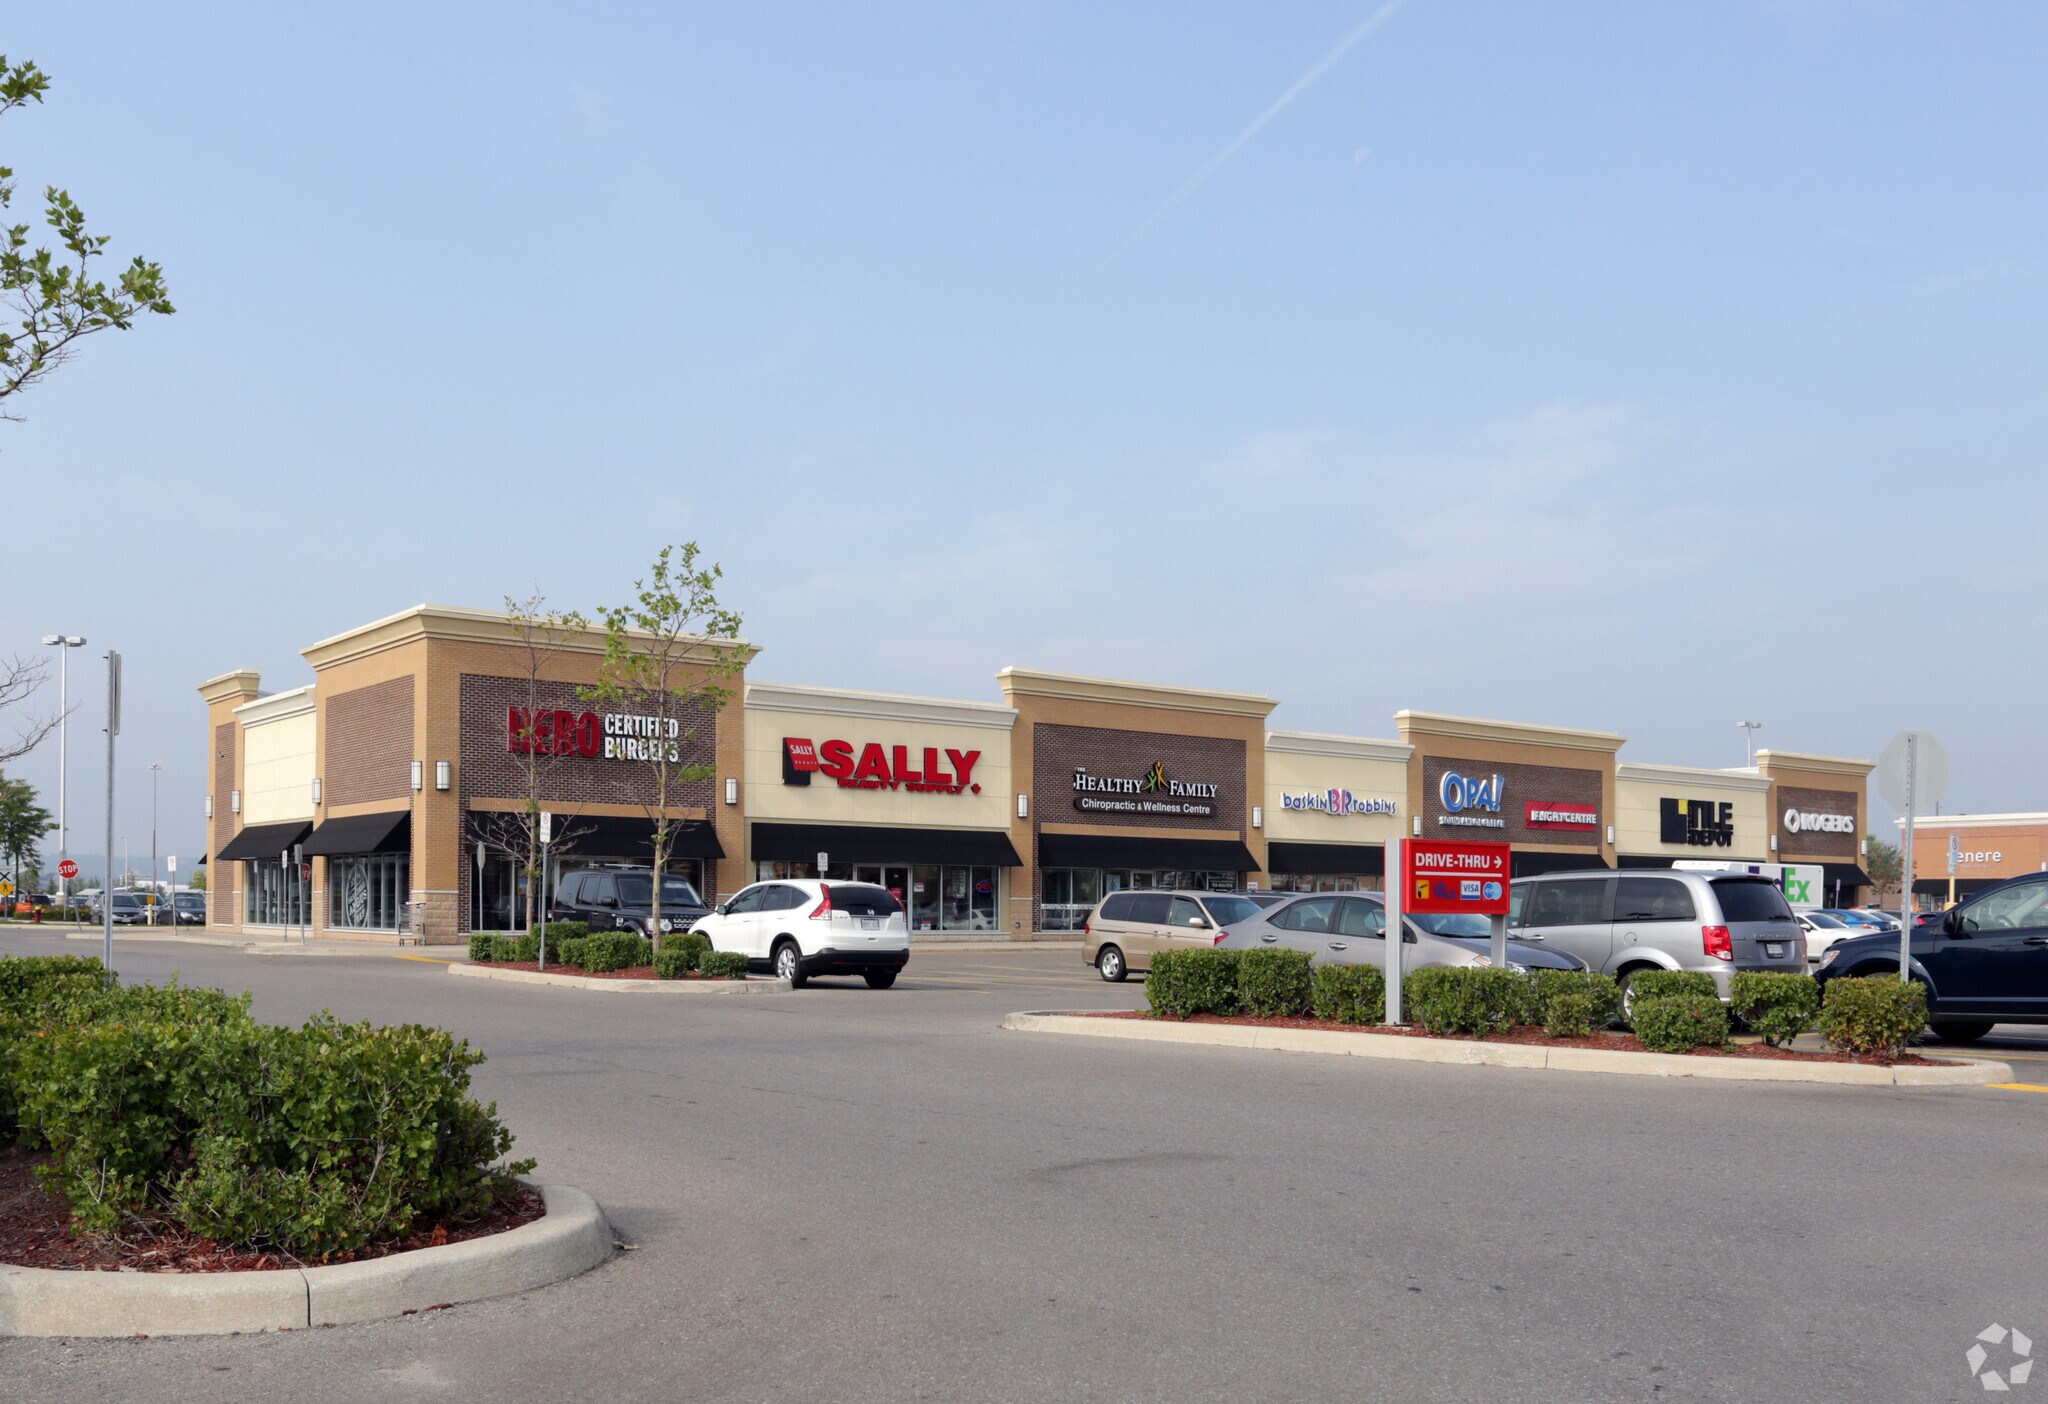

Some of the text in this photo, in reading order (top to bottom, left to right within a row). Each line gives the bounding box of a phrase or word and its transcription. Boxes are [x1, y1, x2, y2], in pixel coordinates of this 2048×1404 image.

[508, 706, 600, 758] HERO
[604, 713, 679, 739] CERTIFIED
[790, 744, 813, 756] SALLY
[820, 740, 981, 785] SALLY
[838, 778, 965, 796] BEAUTY SUPPLY
[1075, 773, 1218, 797] HEALTHY FAMILY
[1439, 770, 1505, 812] OPA!
[1081, 797, 1136, 811] Chiropractic
[1143, 801, 1181, 813] Wellness
[1183, 803, 1211, 815] Centre
[1281, 792, 1327, 810] baskin
[1353, 798, 1396, 815] robbins
[1531, 810, 1597, 824] FLIGHT CENTRE
[1688, 799, 1734, 831] TILE
[1800, 813, 1854, 833] ROGERS
[1689, 830, 1734, 848] DEPOT
[1415, 853, 1490, 868] DRIVE-THRU
[1947, 851, 2001, 863] enere
[58, 865, 78, 874] STOP
[1463, 884, 1479, 892] VISA
